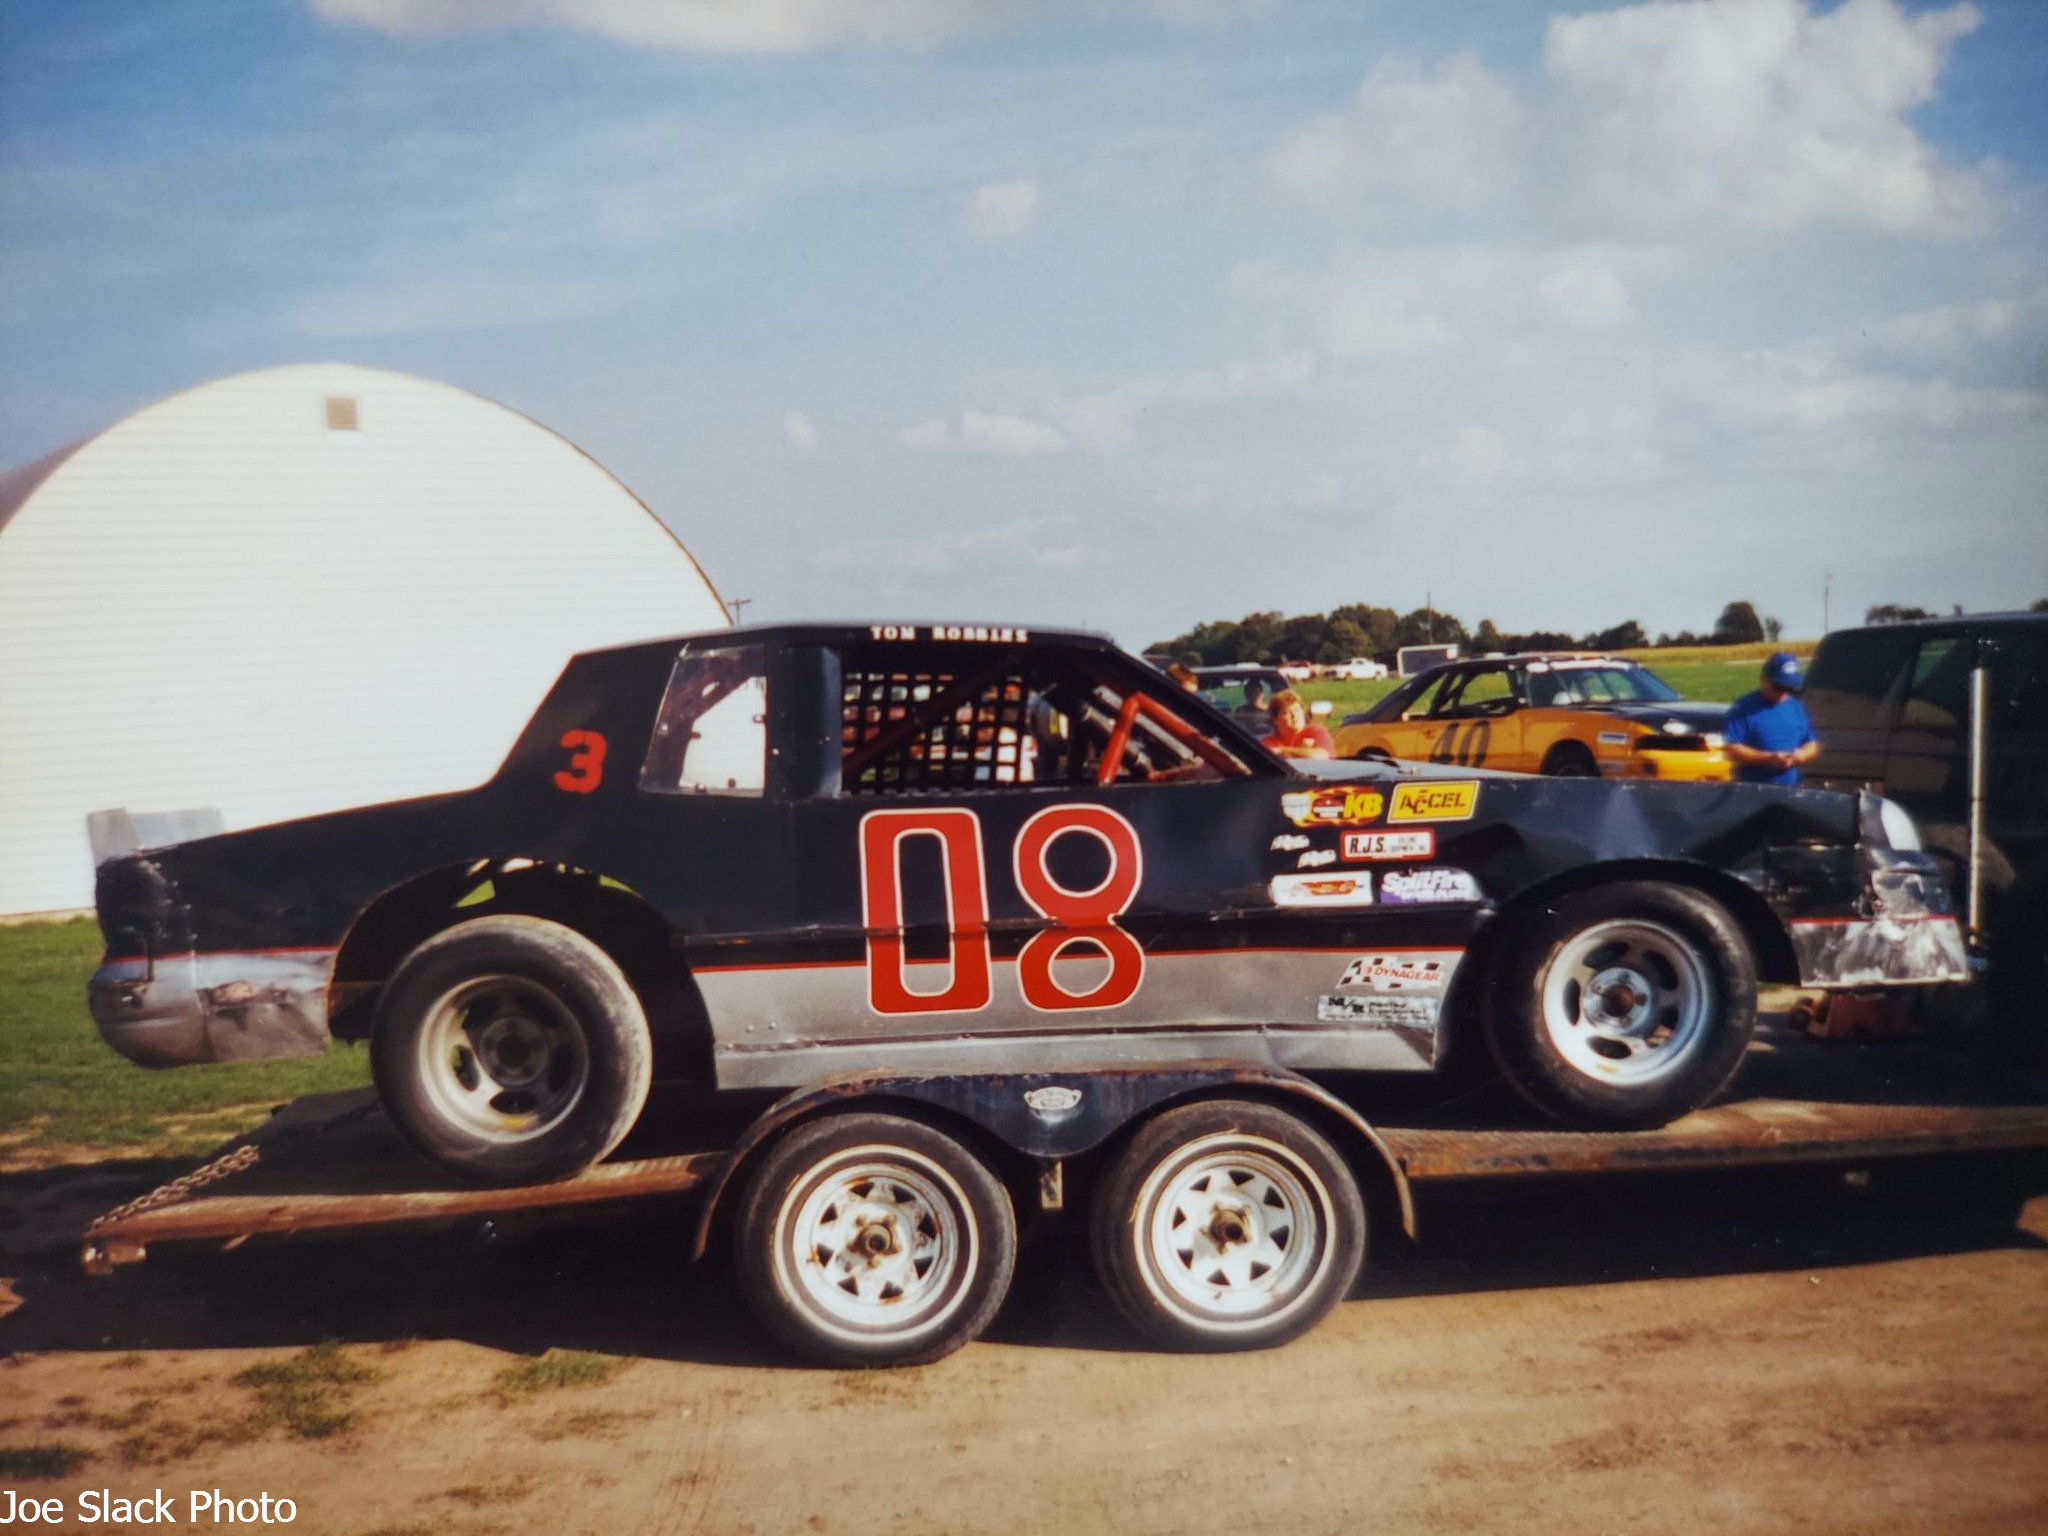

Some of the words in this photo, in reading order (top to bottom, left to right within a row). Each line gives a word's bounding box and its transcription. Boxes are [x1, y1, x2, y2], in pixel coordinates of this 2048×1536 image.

[870, 625, 916, 641] TOM
[553, 729, 608, 794] 3
[1343, 792, 1383, 820] KB
[1399, 789, 1466, 815] ACCEL
[859, 803, 1145, 1017] 08
[1374, 966, 1440, 982] DYNAGEAR
